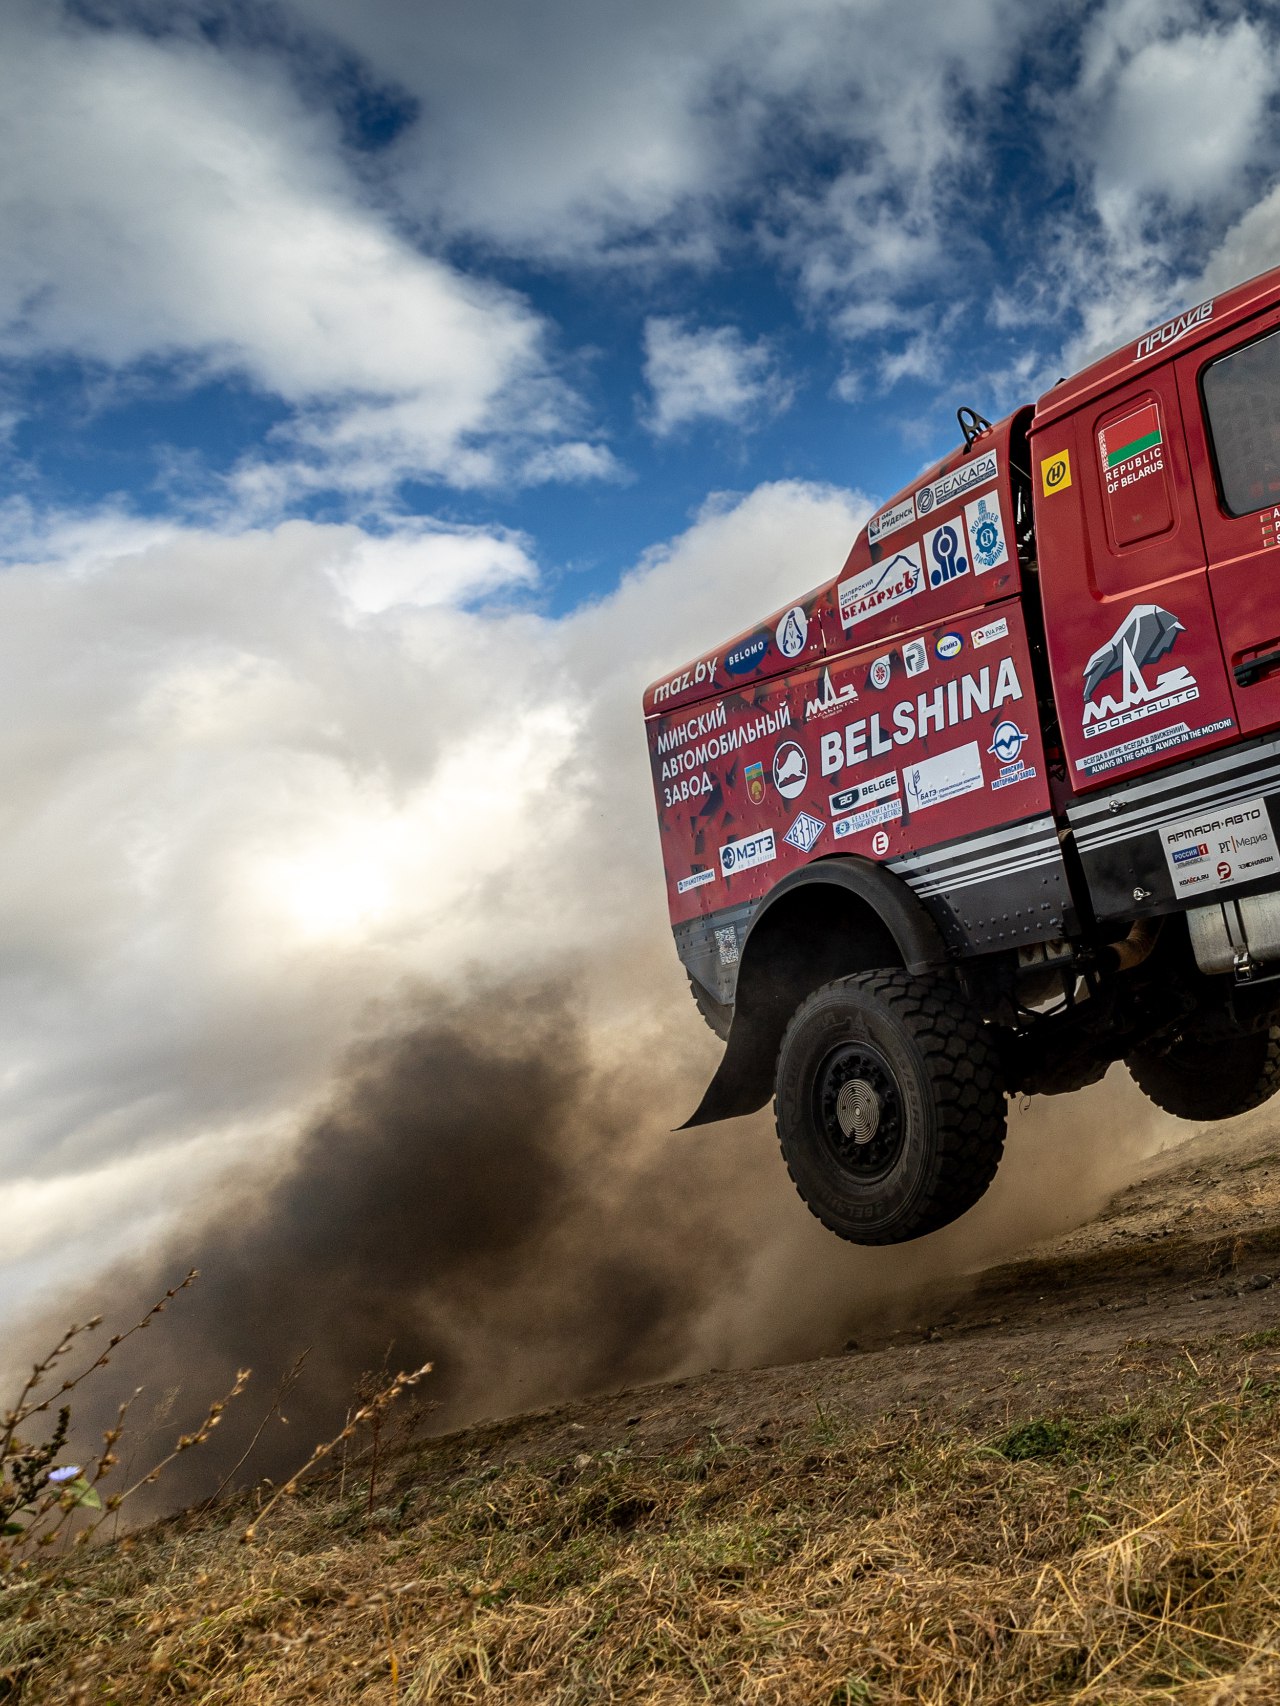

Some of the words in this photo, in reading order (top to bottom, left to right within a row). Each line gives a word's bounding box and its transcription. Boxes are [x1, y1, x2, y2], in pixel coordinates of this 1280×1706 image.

[1136, 300, 1214, 359] ПРОЛИВ
[934, 458, 996, 499] БЕЛКАРД
[1105, 447, 1162, 483] REPUBLIC
[1107, 478, 1119, 494] OF
[1121, 460, 1164, 488] BELARUS
[881, 506, 913, 529] РУДЕНСК
[840, 578, 874, 600] ДИЛЕРСКИЙ
[840, 593, 859, 606] ЦЕНТР
[728, 641, 764, 666] BELOMO
[653, 656, 718, 705] maz.by
[820, 655, 1024, 778] BELSHINA
[1085, 688, 1197, 737] SPORTAUTO
[657, 701, 727, 756] МИНСКИЙ
[661, 700, 792, 782] АВТОМОБИЛЬНЫЙ
[1084, 753, 1104, 766] ВСЕГДА
[1123, 740, 1145, 752] ВСЕГДА
[1091, 760, 1116, 774] ALWAYS
[1116, 757, 1123, 765] IN
[1123, 753, 1135, 762] THE
[1155, 736, 1181, 752] ALWAYS
[1181, 733, 1189, 742] IN
[1189, 729, 1202, 739] THE
[1201, 718, 1232, 735] MOTION!
[663, 771, 714, 808] ЗАВОД
[861, 775, 897, 796] BELGEE
[920, 789, 937, 801] БАТЭ
[736, 835, 774, 862] МЭТЗ
[876, 834, 886, 849] E
[1174, 848, 1198, 861] РОССИЯ
[1218, 840, 1231, 854] РГ
[1236, 833, 1268, 848] Медиа
